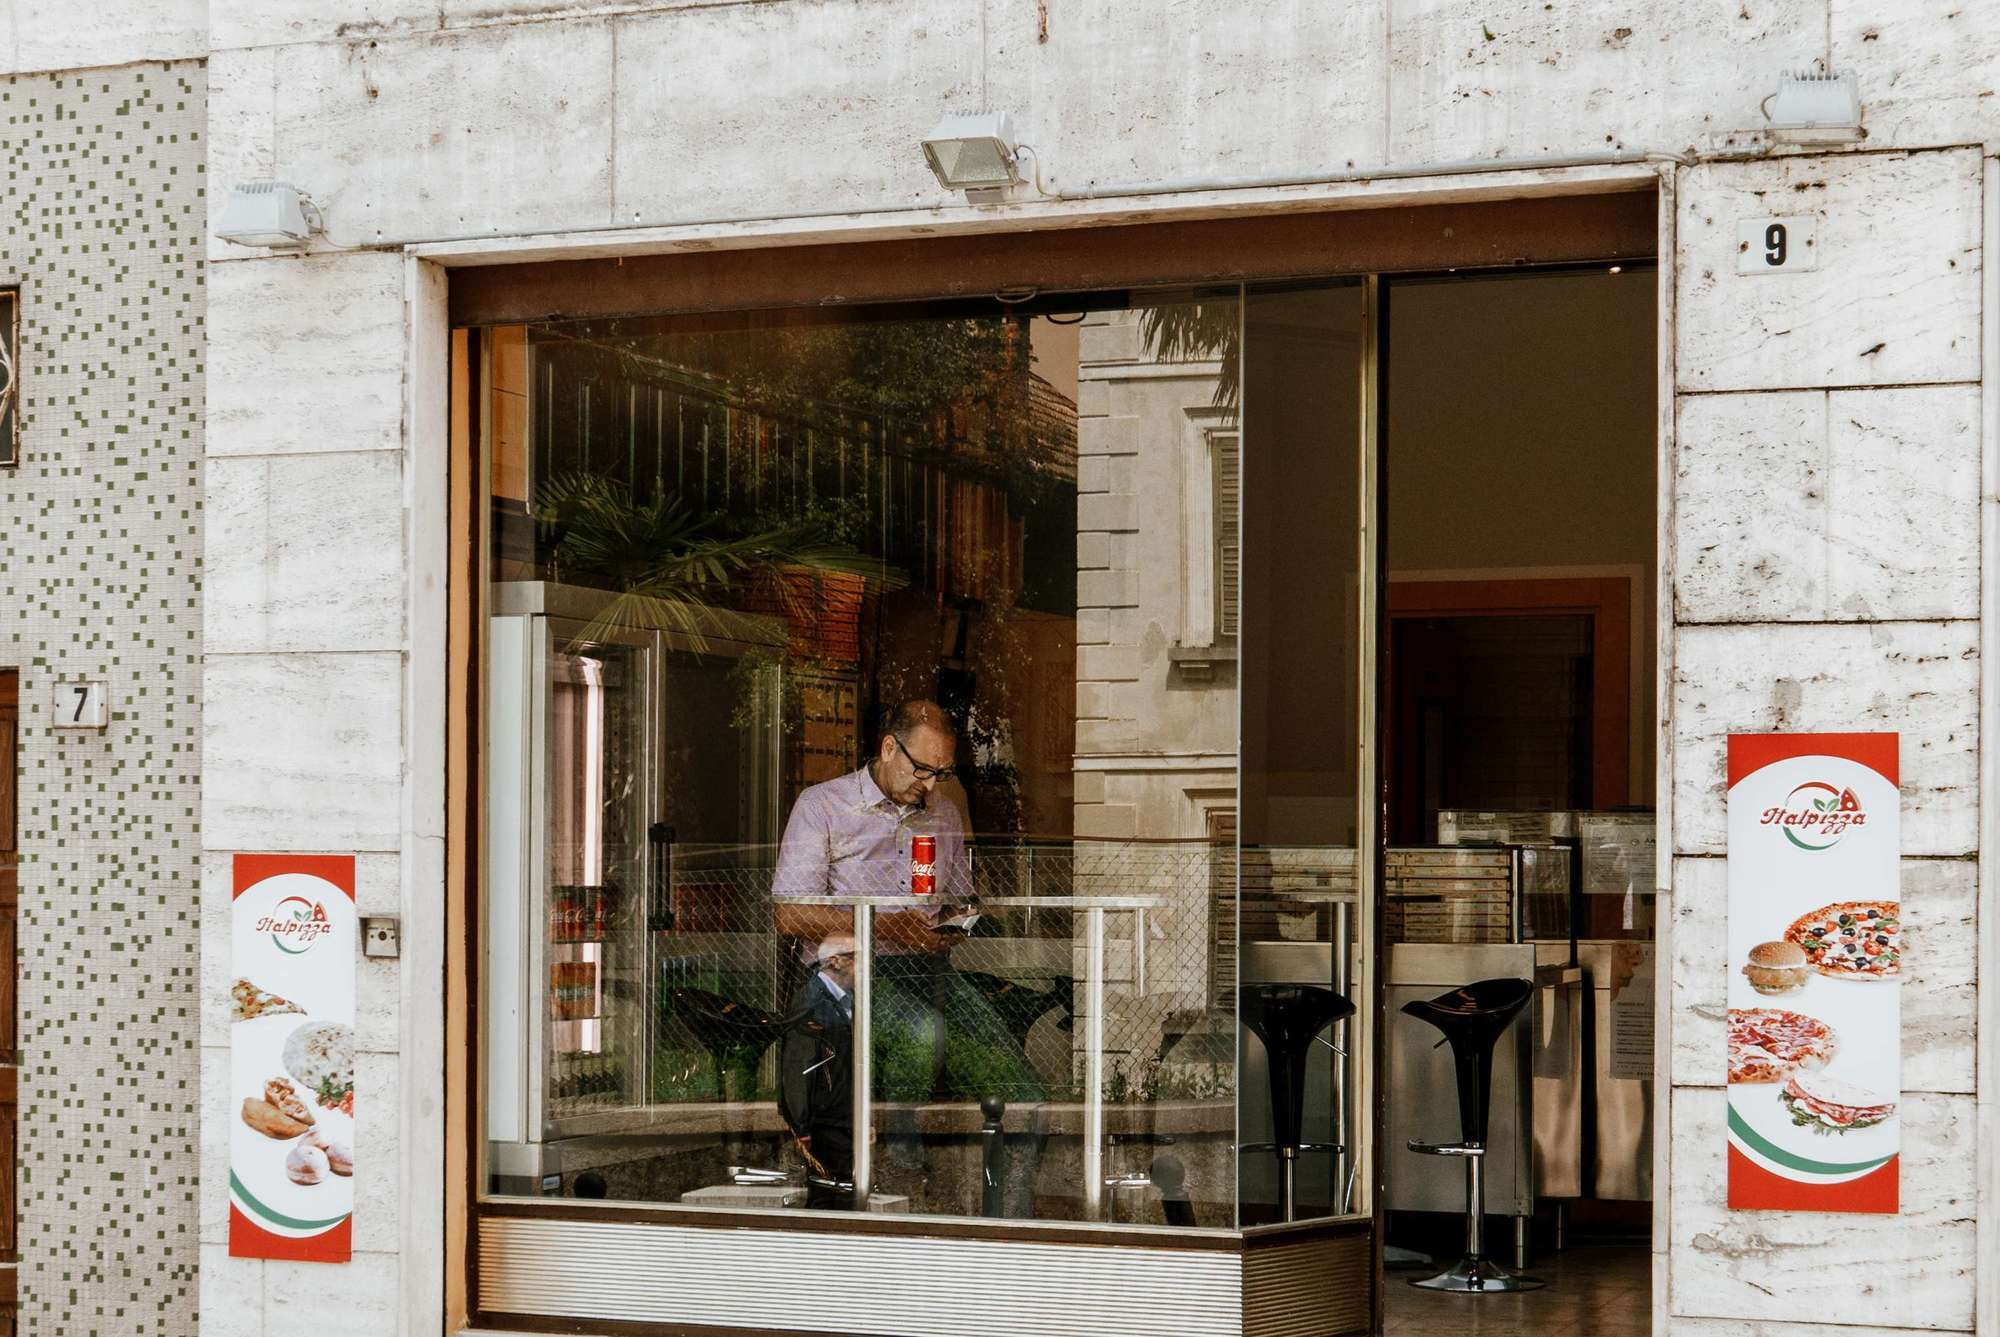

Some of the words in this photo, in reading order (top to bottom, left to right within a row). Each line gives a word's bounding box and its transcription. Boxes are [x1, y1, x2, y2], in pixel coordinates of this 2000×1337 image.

[1765, 223, 1787, 266] 9
[73, 687, 88, 722] 7
[1760, 807, 1866, 835] Italpizza
[255, 917, 331, 942] Italpizza
